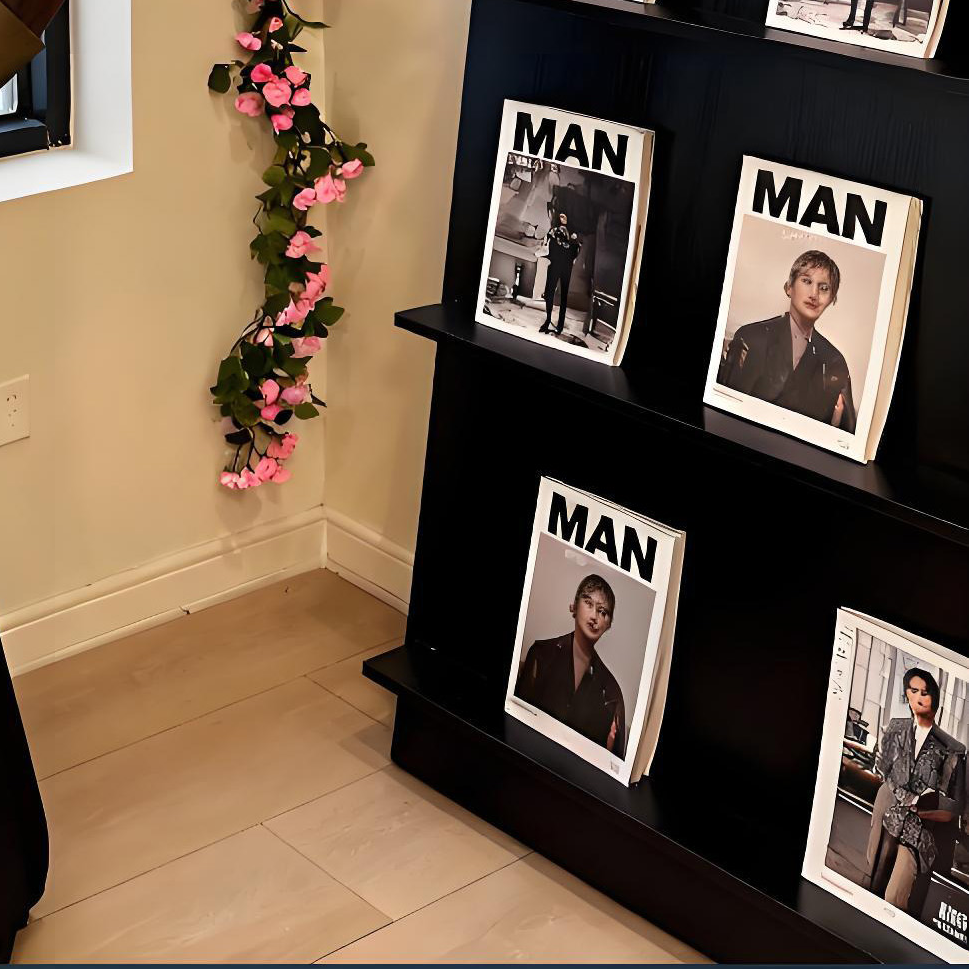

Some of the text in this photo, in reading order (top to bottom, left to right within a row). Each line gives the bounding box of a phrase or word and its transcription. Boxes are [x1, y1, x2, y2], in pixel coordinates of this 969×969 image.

[512, 111, 630, 177] MAN
[752, 168, 888, 247] MAN
[547, 491, 658, 584] MAN
